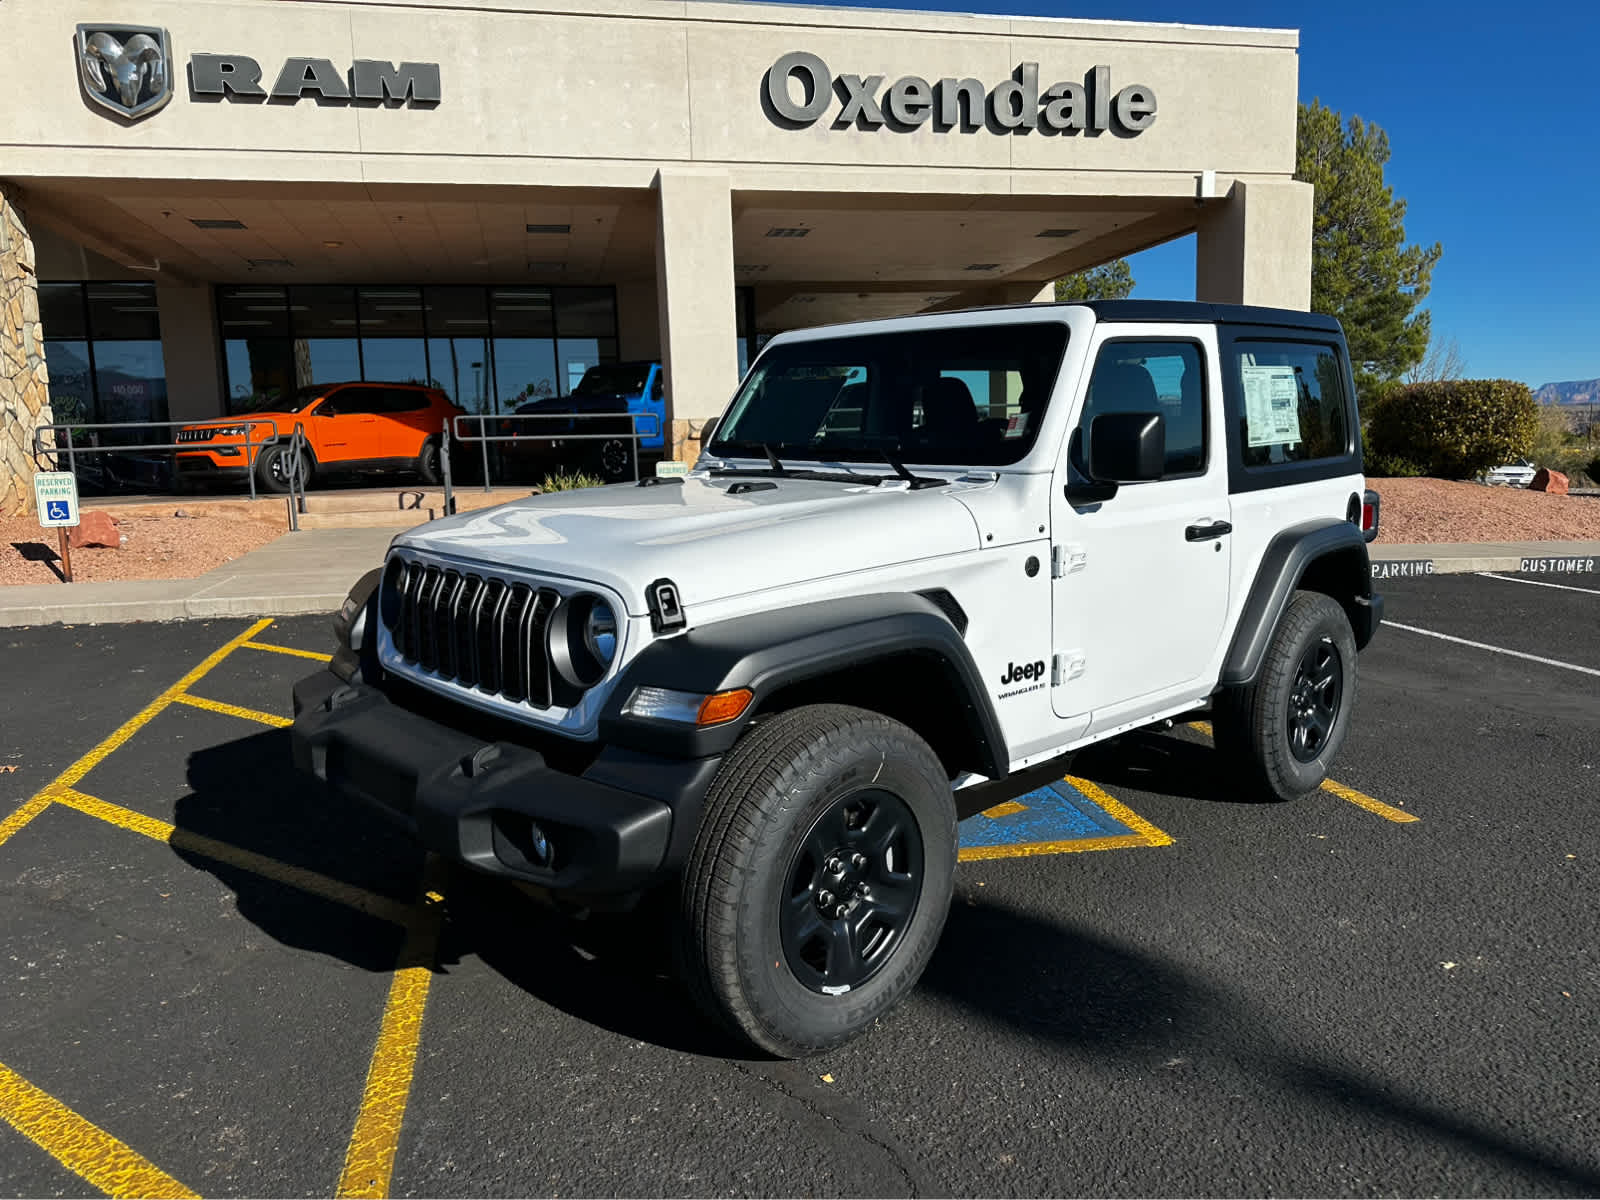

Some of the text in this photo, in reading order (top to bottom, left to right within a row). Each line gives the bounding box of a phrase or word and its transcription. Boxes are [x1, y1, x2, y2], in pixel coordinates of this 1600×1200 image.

[190, 52, 441, 107] RAM
[763, 51, 1157, 136] Oxendale
[37, 478, 72, 486] RESERVED
[40, 487, 72, 496] PARKING
[1371, 561, 1434, 577] PARKING
[1520, 558, 1595, 573] CUSTOMER
[1001, 660, 1045, 684] Jeep
[998, 685, 1038, 699] WRANGLER
